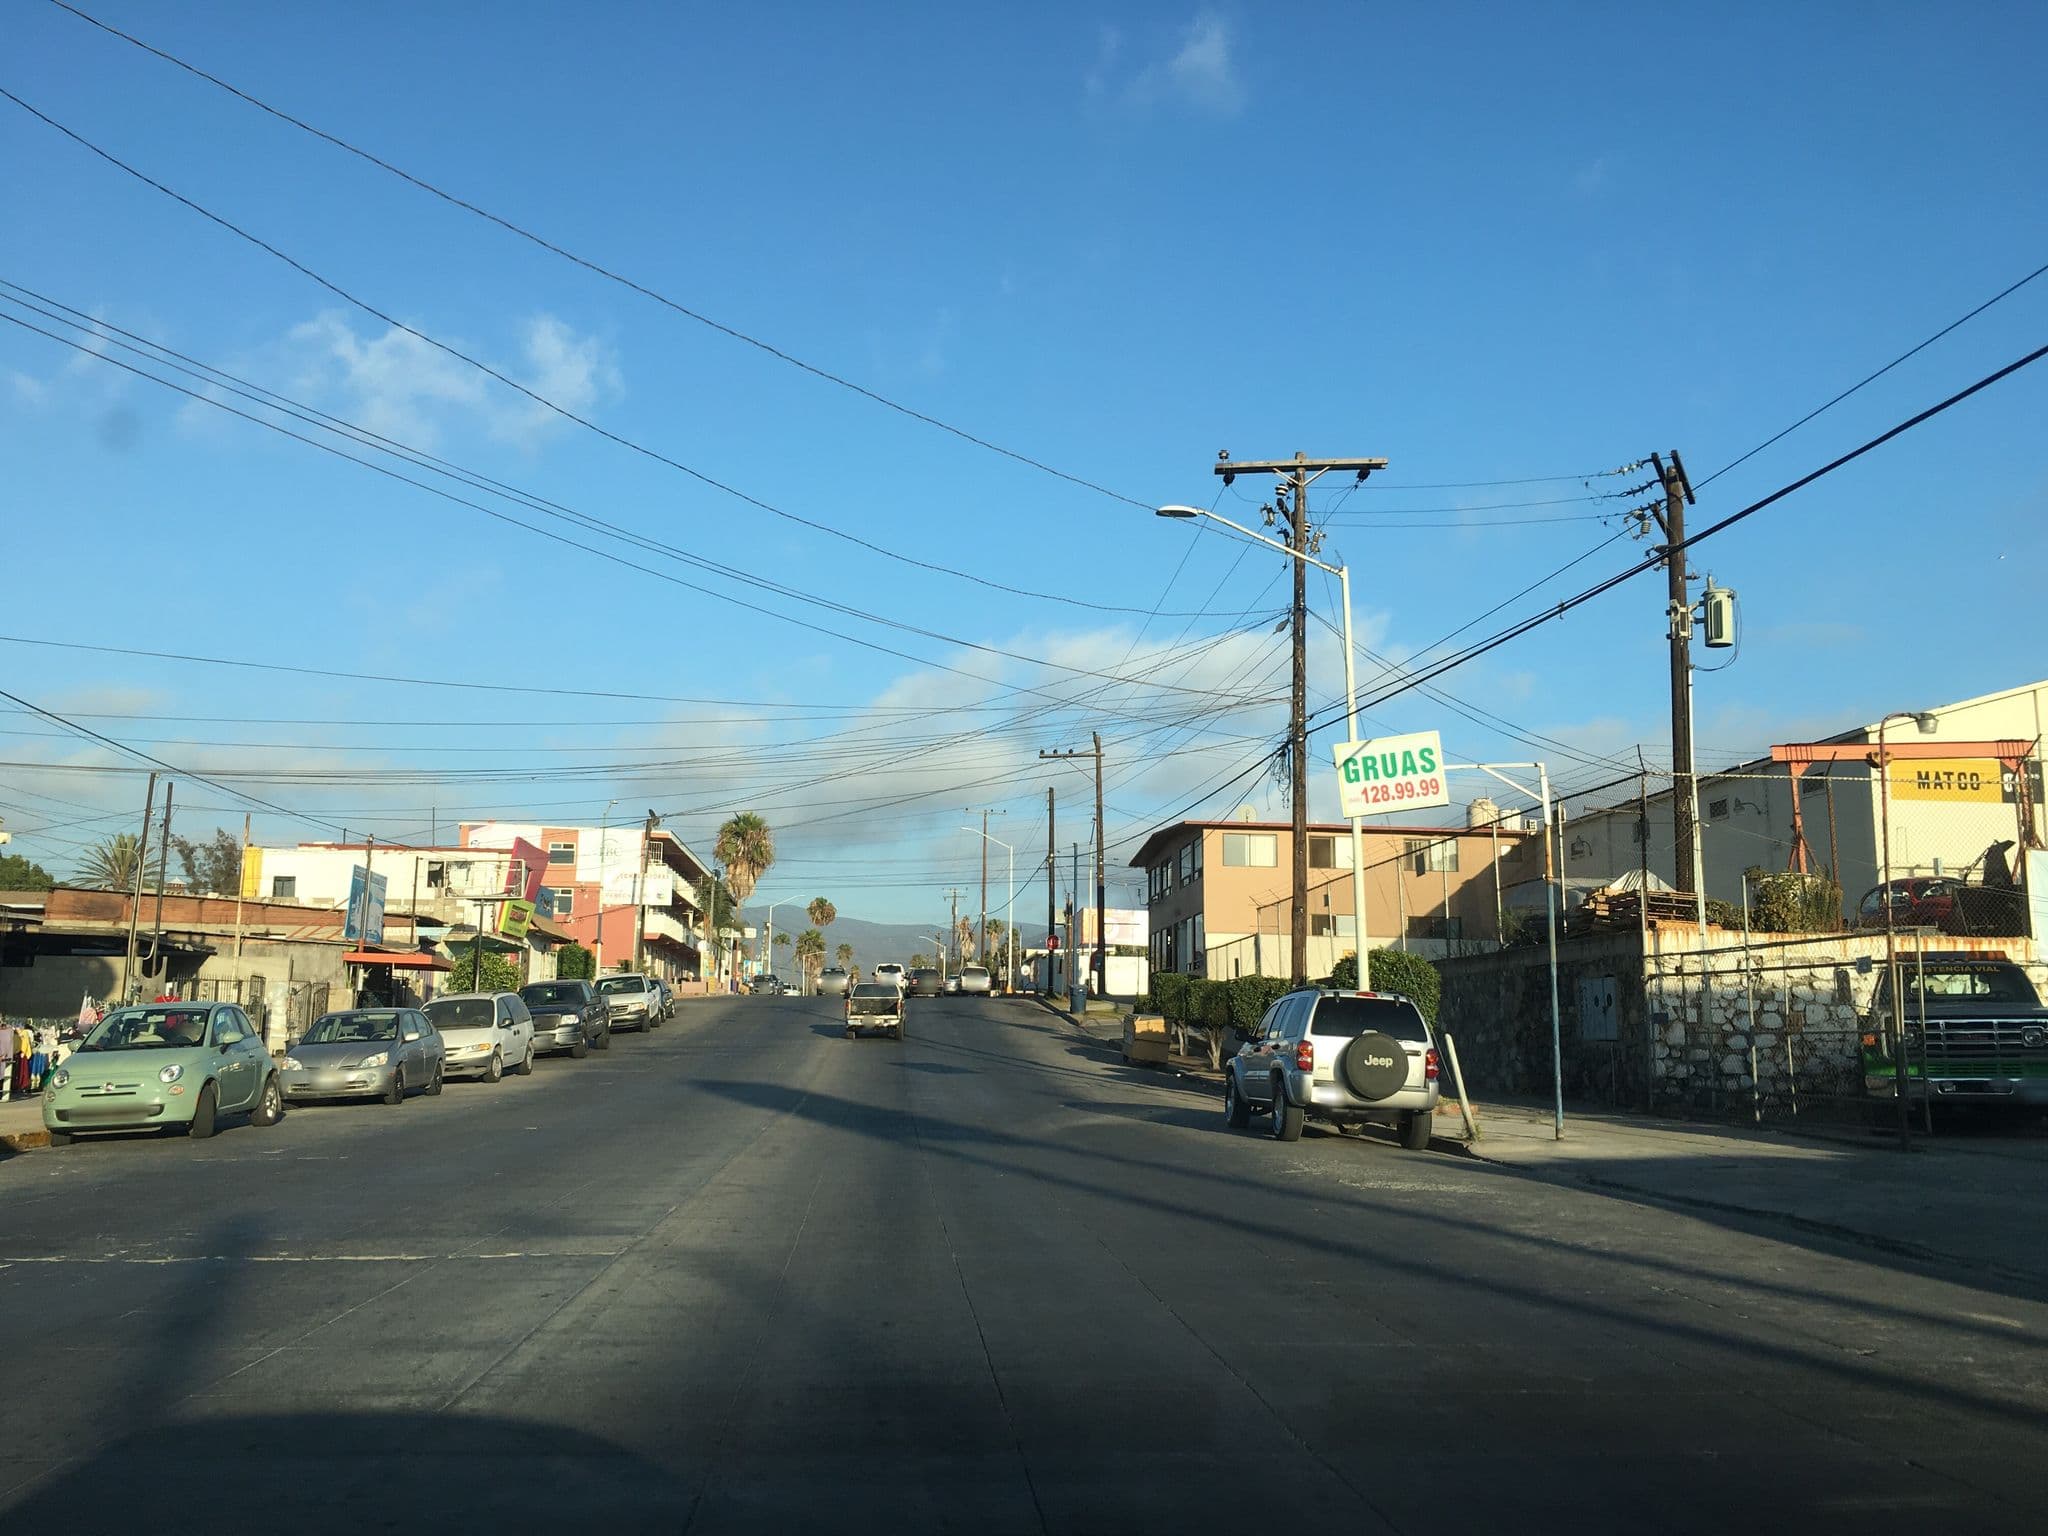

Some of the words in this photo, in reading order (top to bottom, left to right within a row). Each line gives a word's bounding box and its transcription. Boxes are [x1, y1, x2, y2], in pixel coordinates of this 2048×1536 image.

[1343, 747, 1436, 784] GRUAS
[1361, 778, 1440, 804] 128.99.99
[1917, 771, 1980, 790] MATCO
[1364, 1054, 1393, 1068] Jeep
